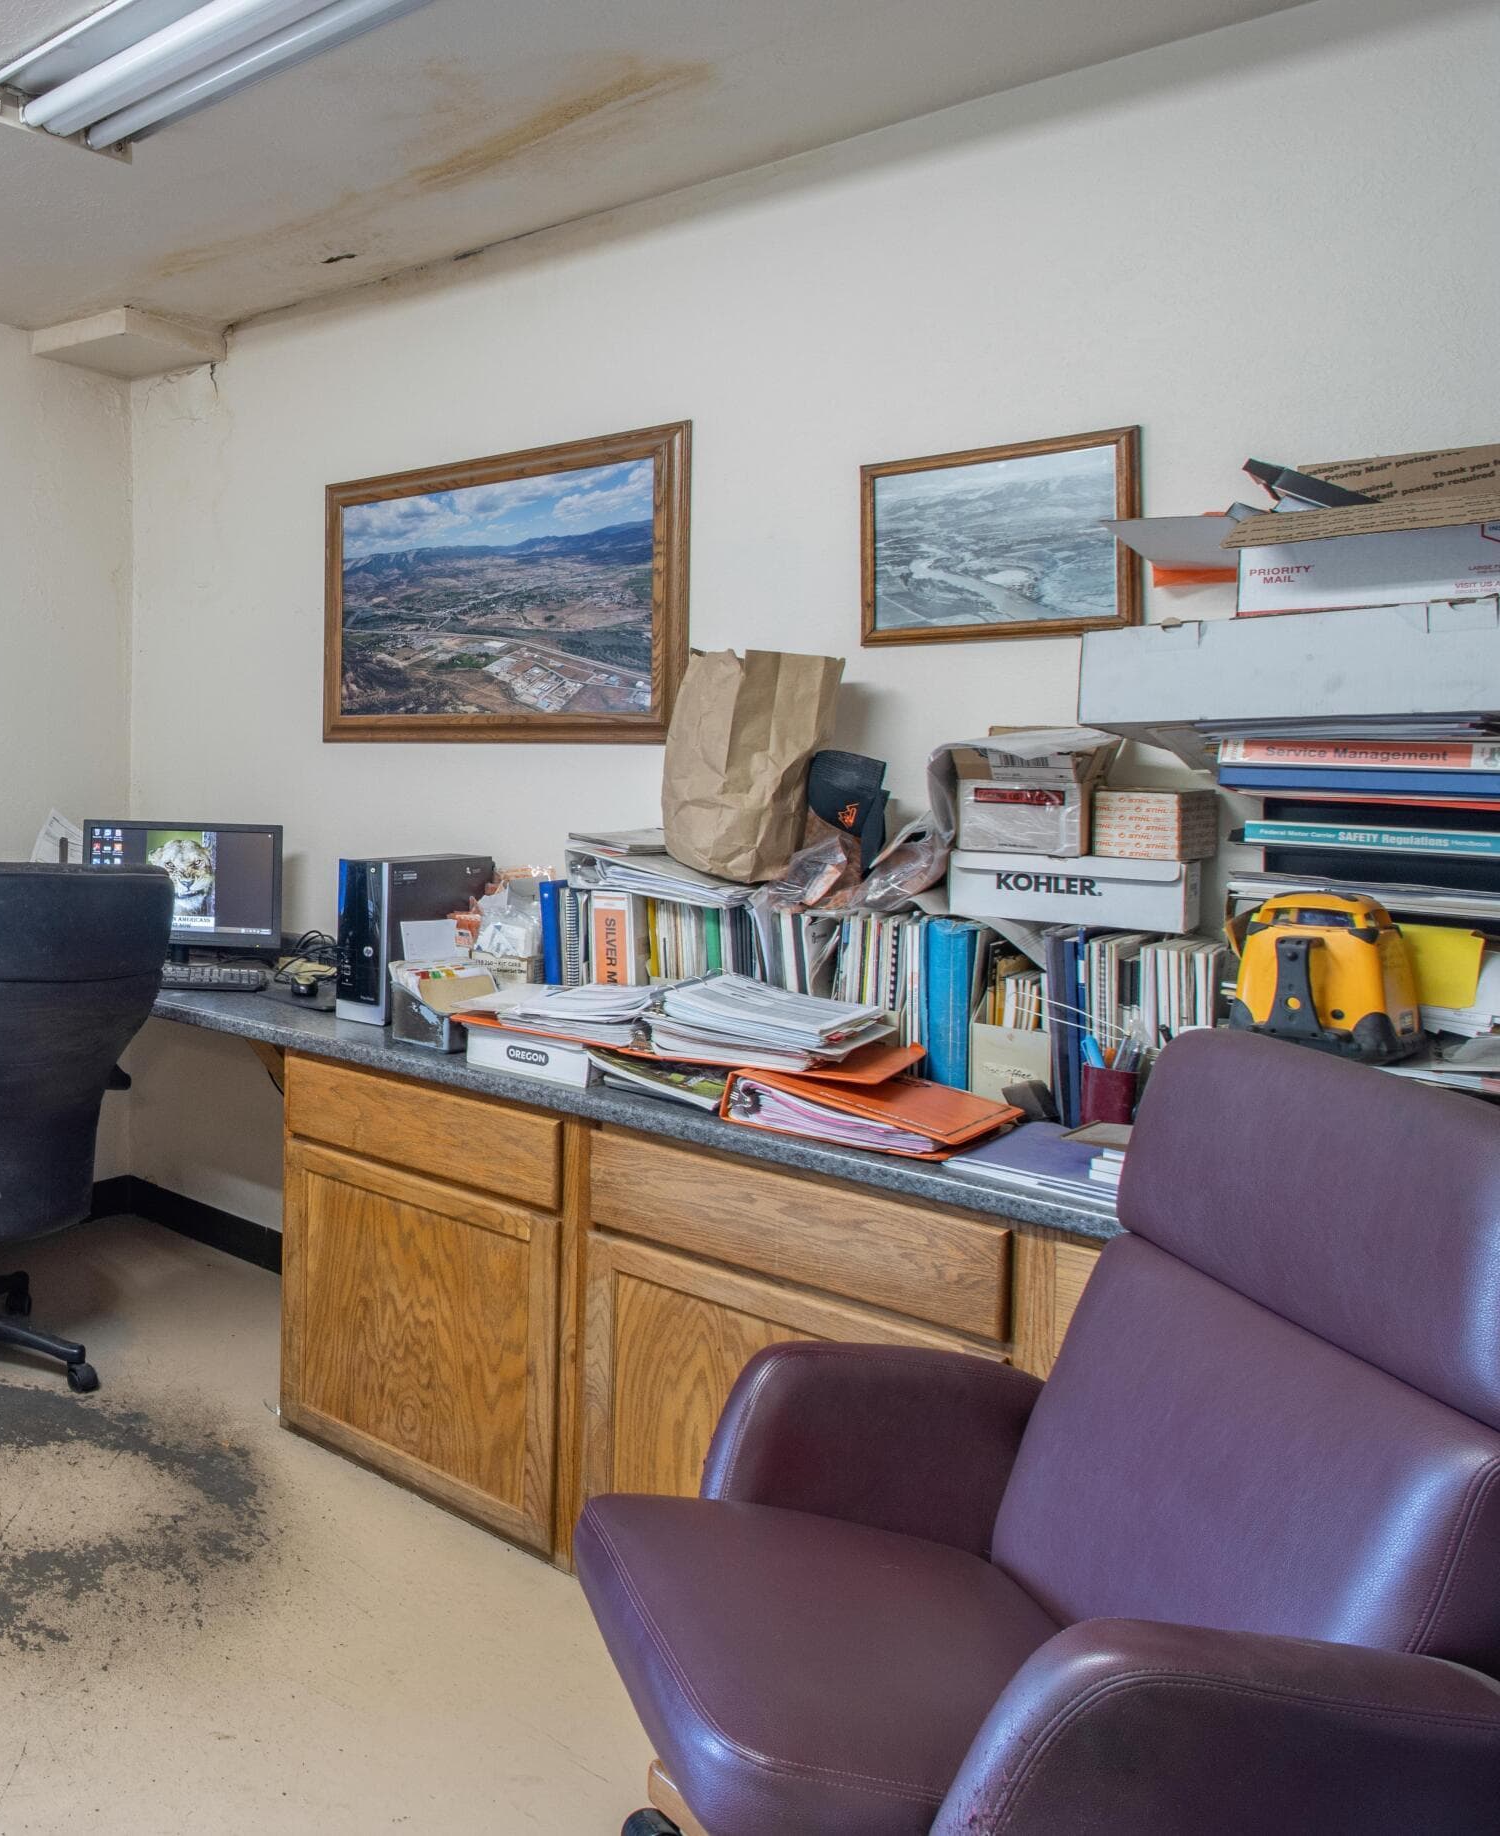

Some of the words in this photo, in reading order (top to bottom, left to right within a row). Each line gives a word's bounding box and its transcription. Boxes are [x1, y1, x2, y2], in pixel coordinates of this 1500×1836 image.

[1324, 469, 1361, 482] Priority
[1395, 453, 1438, 468] postage
[1433, 467, 1466, 479] Thank
[1470, 462, 1489, 473] you
[1401, 482, 1444, 496] postage
[1448, 471, 1495, 486] required
[1262, 575, 1295, 584] MAIL
[1265, 745, 1327, 758] Service
[1333, 747, 1448, 762] Management
[1259, 828, 1286, 836] Federal
[1338, 831, 1380, 843] SAFETY
[1381, 834, 1449, 847] Regulations
[1451, 839, 1492, 847] Handbook
[604, 916, 617, 968] SILVER
[509, 1047, 547, 1064] OREGON
